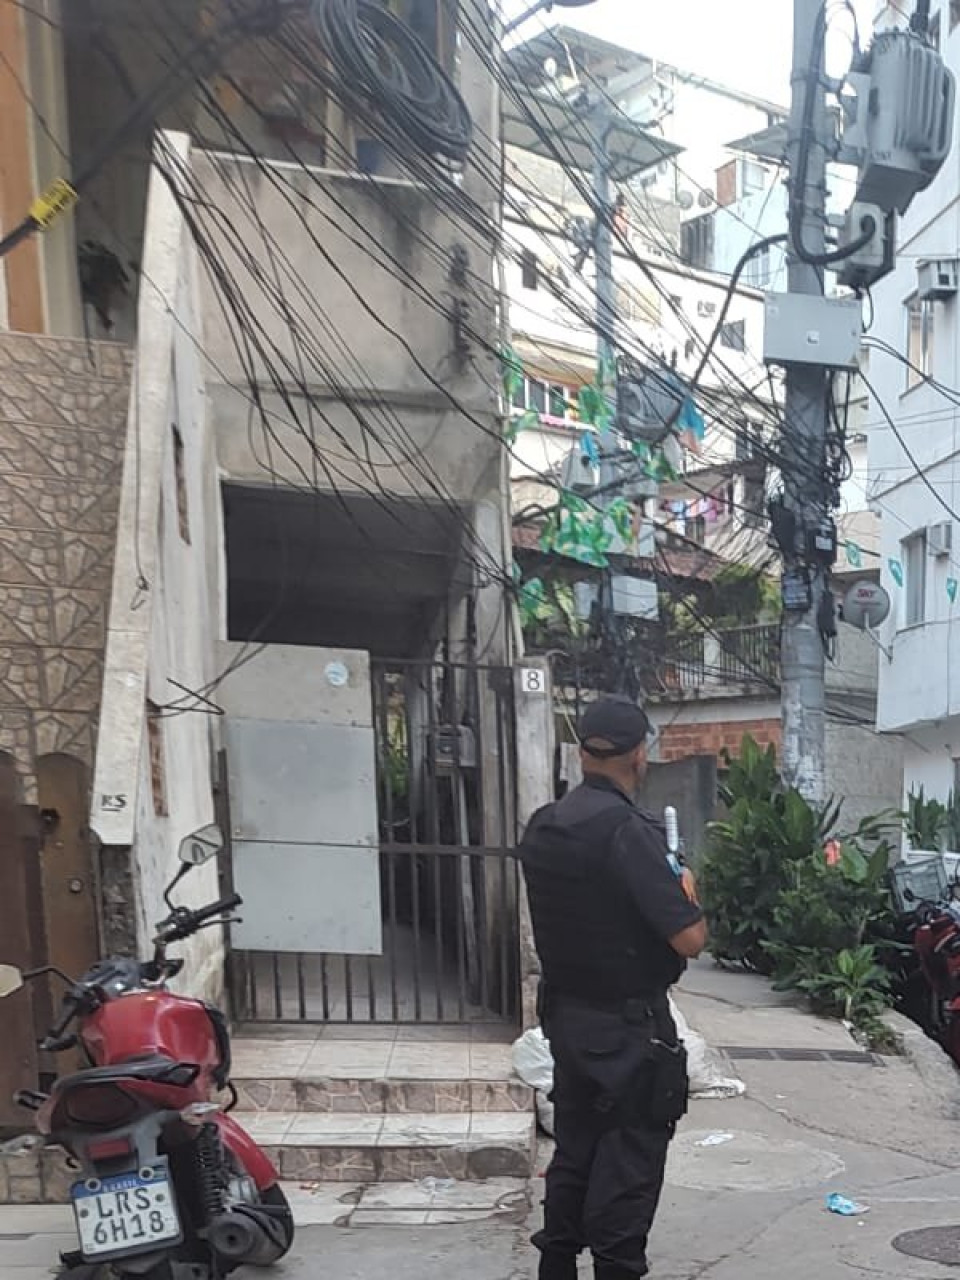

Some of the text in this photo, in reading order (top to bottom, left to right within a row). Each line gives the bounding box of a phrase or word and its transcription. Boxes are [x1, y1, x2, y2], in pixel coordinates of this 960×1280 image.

[527, 671, 540, 690] 8
[97, 1188, 151, 1217] LRS
[94, 1211, 164, 1244] 6H18
